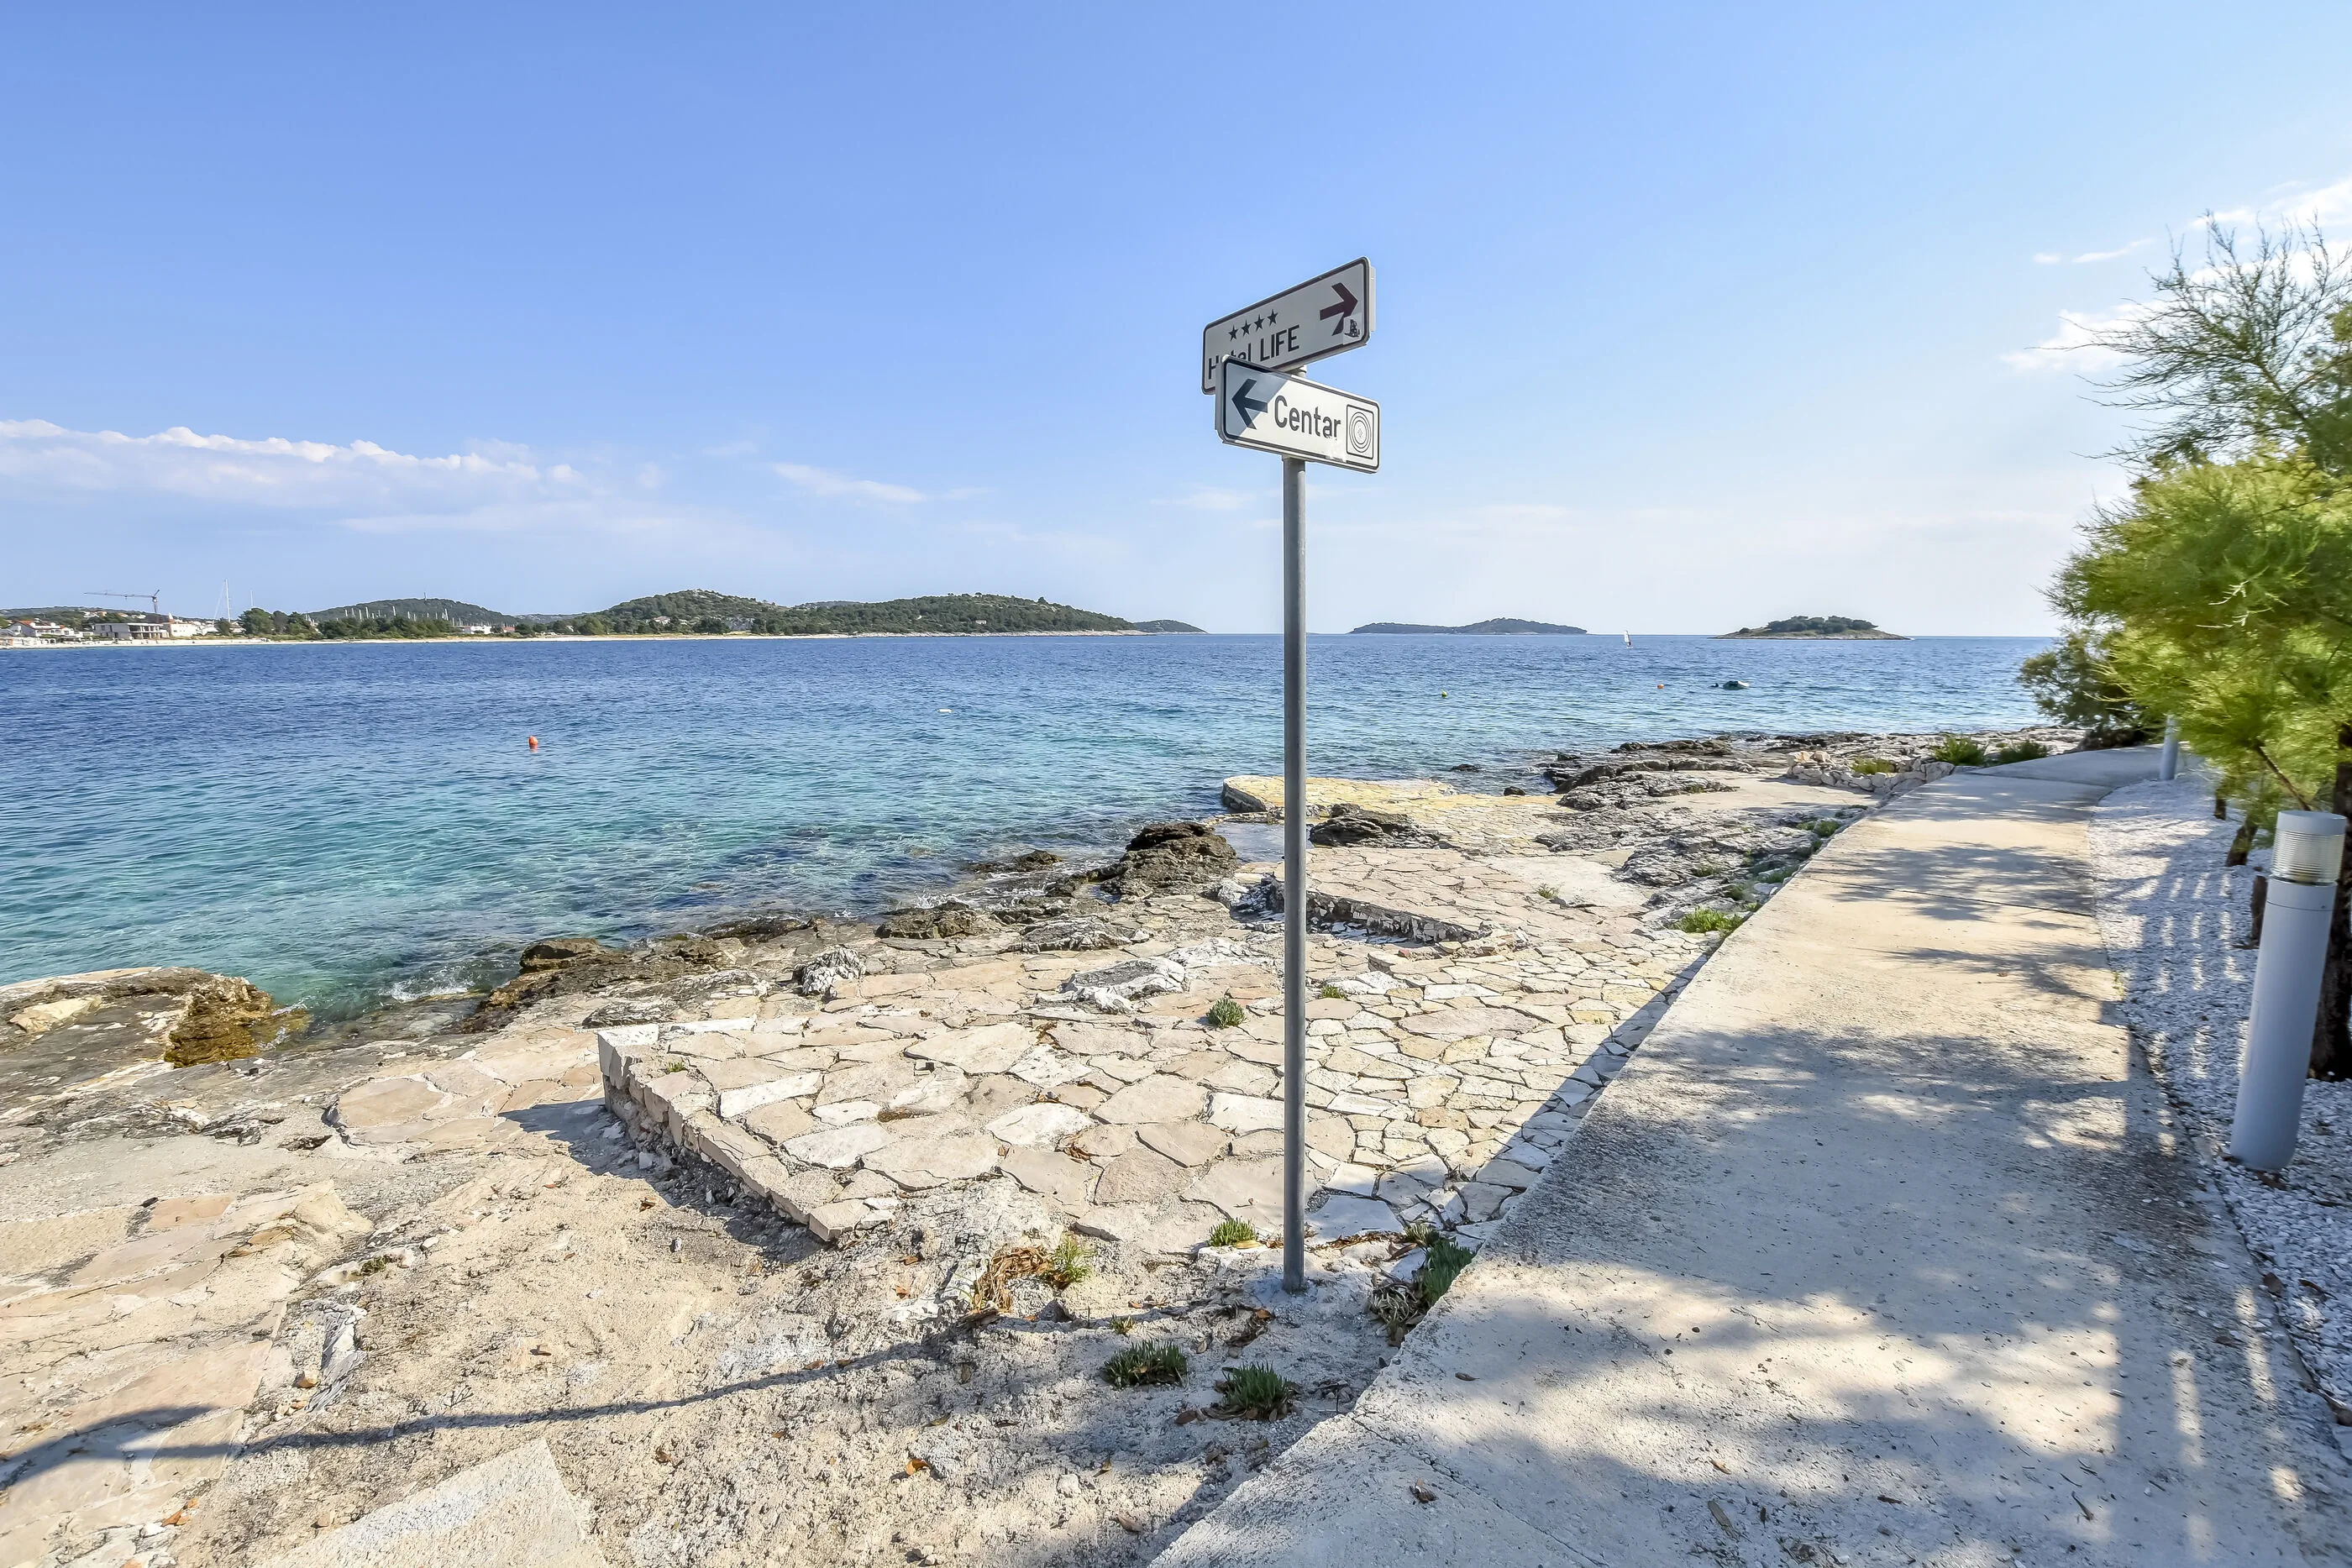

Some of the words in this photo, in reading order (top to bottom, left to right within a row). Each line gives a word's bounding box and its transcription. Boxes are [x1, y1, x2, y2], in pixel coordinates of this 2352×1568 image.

[1208, 342, 1252, 380] Hel
[1260, 324, 1300, 362] LIFE
[1274, 395, 1341, 438] Centar
